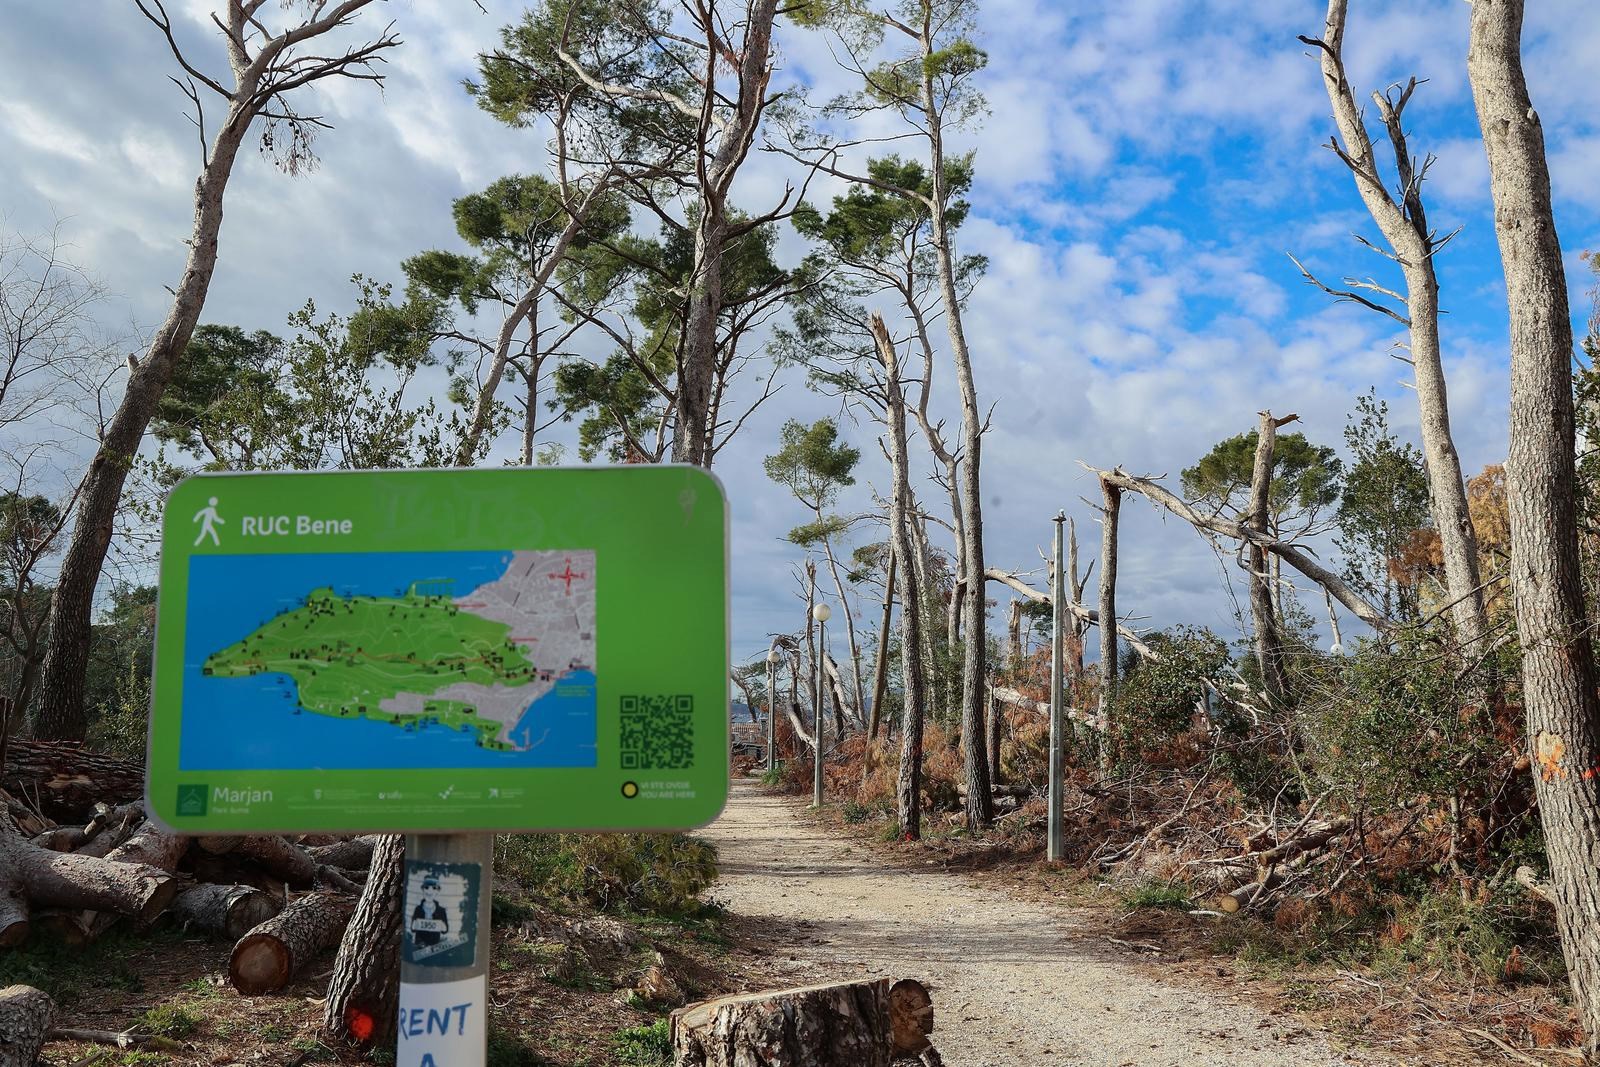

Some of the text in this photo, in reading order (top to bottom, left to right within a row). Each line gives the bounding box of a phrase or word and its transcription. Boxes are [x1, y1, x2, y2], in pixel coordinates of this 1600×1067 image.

[241, 515, 353, 536] RUC Bene
[213, 786, 273, 806] Marjan
[420, 921, 437, 929] 1950
[399, 1003, 472, 1040] RENT
